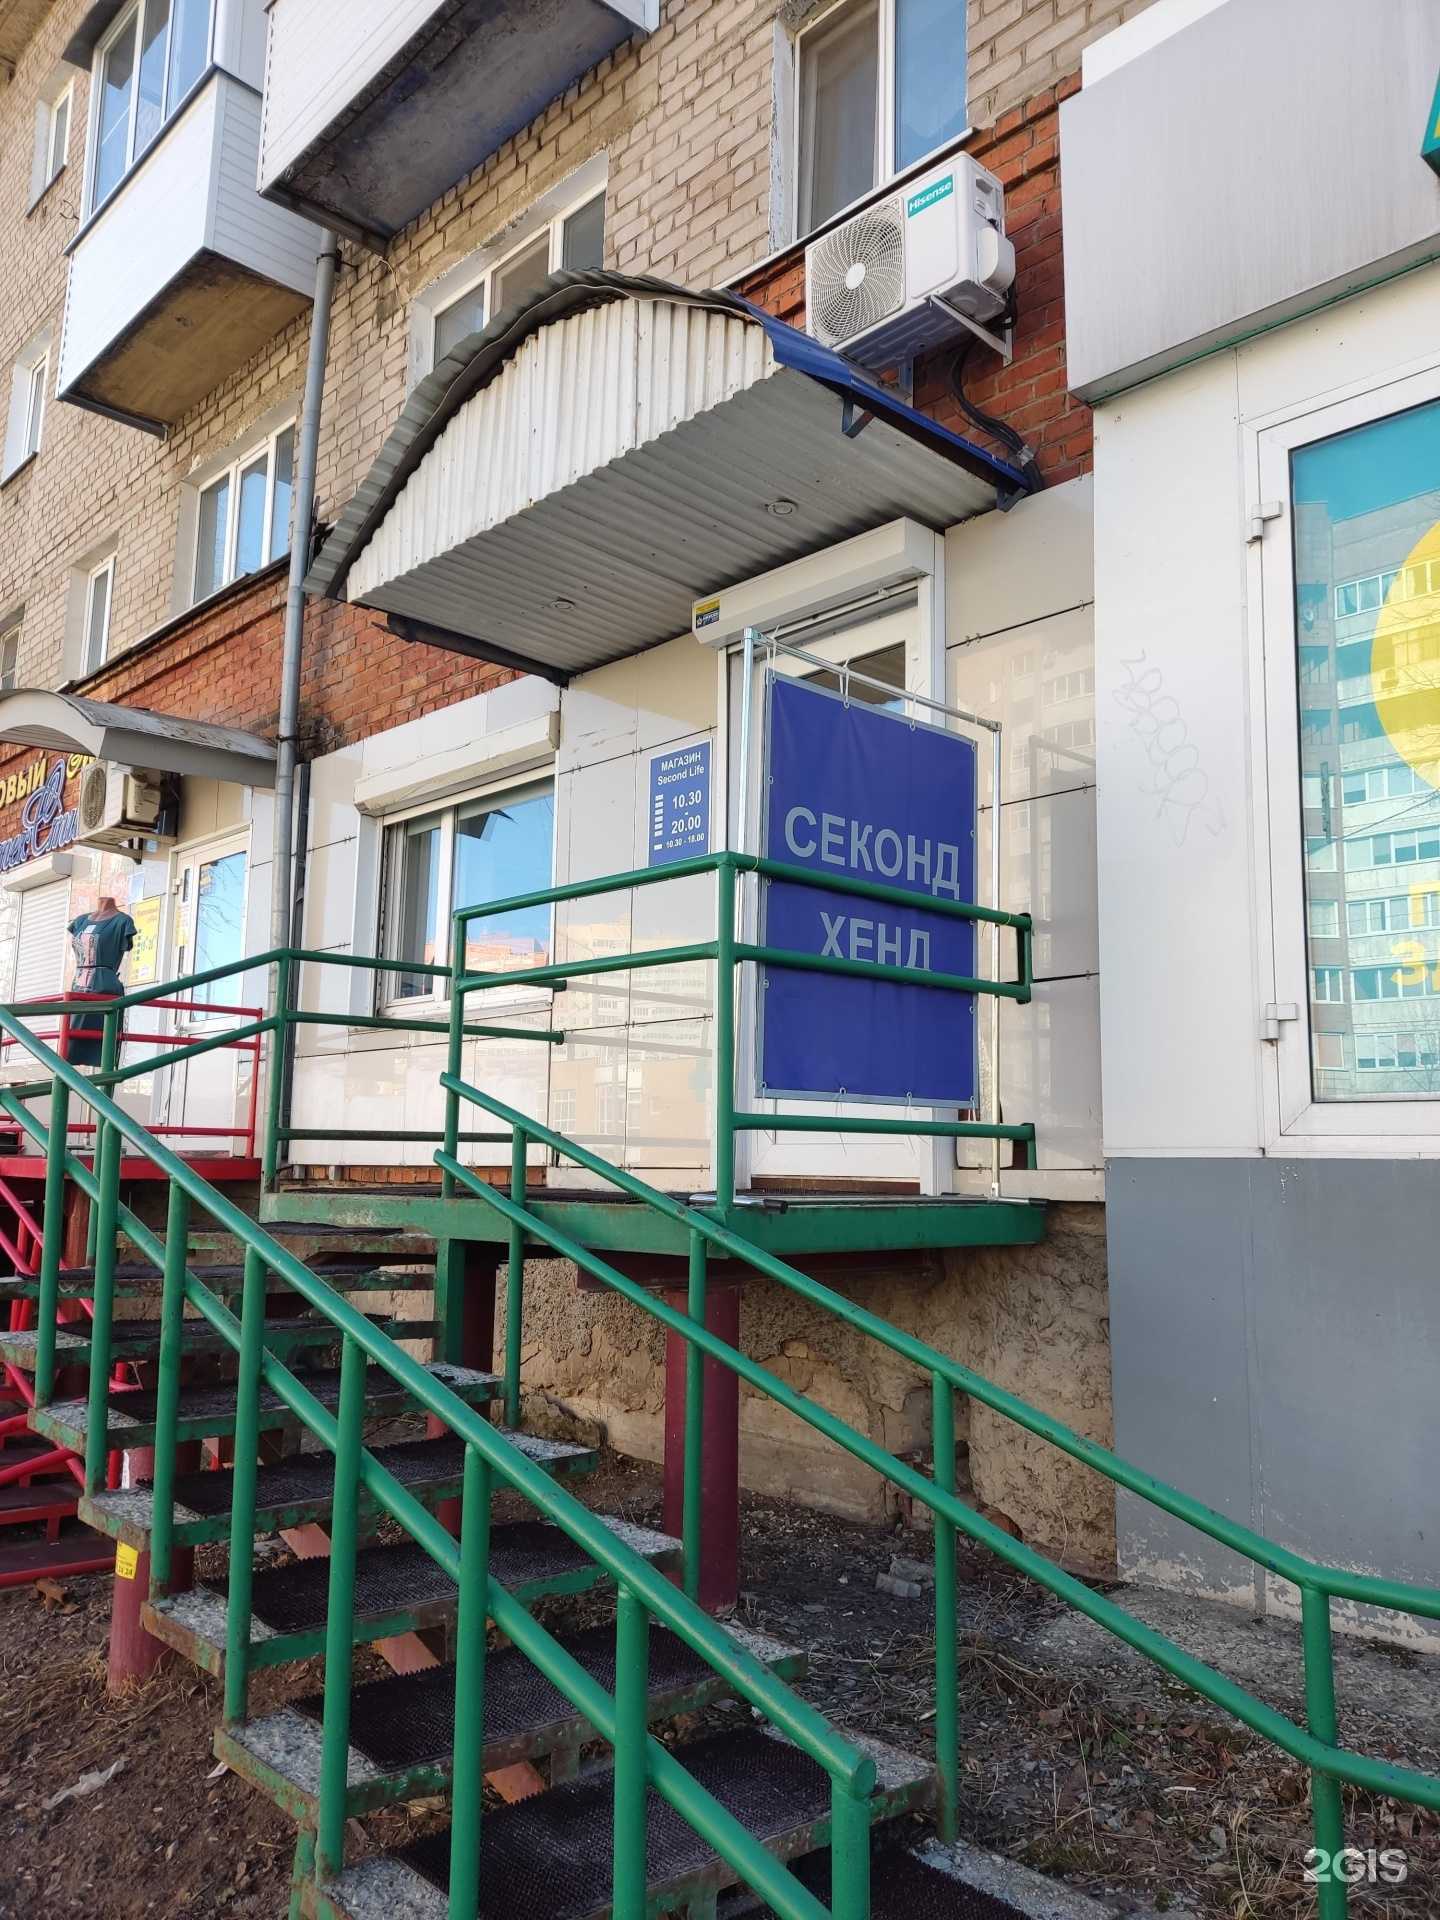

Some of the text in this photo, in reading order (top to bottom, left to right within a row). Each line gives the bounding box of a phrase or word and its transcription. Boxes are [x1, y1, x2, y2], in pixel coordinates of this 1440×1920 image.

[909, 182, 952, 212] Hisense
[661, 752, 701, 772] МАГАЗИН
[657, 765, 705, 786] Second Life
[672, 789, 702, 809] 10.30
[671, 815, 701, 834] 20.00
[785, 806, 960, 901] СЕКОНД
[819, 911, 932, 971] ХЕНД
